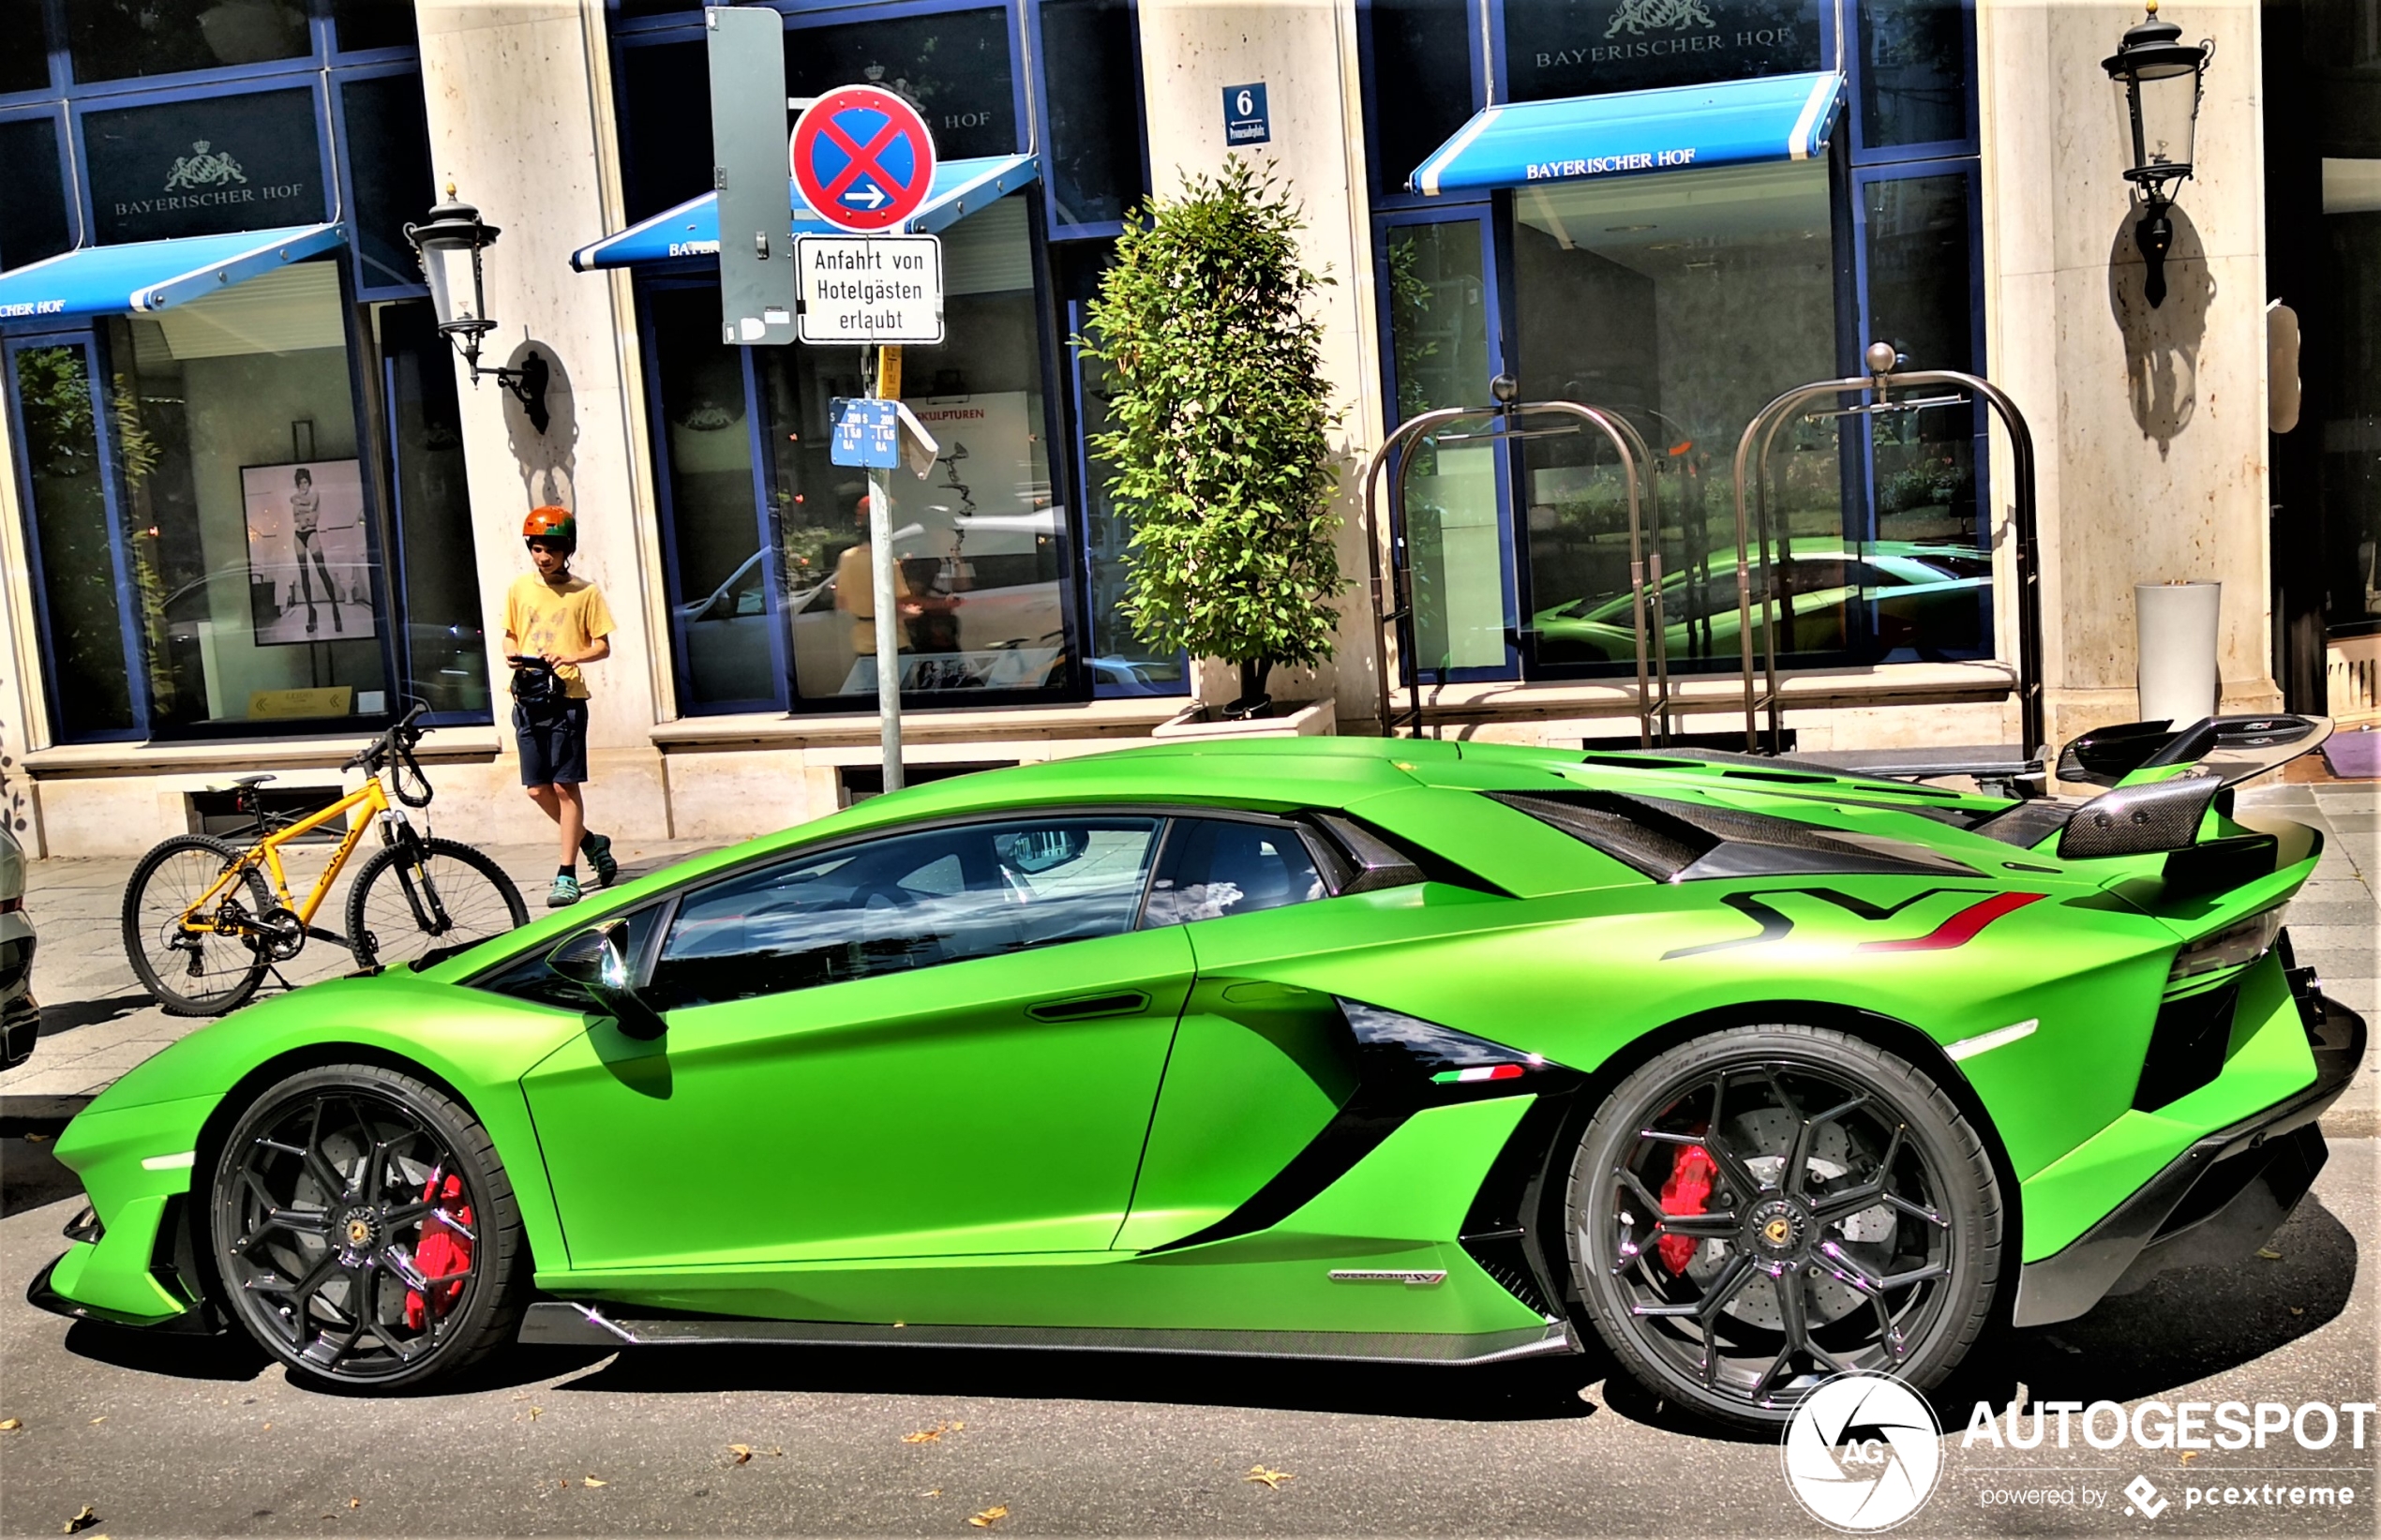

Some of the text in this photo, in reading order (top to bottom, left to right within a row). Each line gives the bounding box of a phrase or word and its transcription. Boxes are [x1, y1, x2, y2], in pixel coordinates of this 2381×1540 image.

[1535, 35, 1723, 67] BAYERISCHER
[1236, 89, 1253, 116] 6
[945, 112, 991, 129] HOF
[1526, 148, 1696, 180] BAYERISCHER HOF
[115, 183, 304, 216] BAYERISCHER HOF
[815, 249, 923, 270] Anfahrt von
[817, 279, 921, 306] Hotelgästen
[37, 299, 67, 314] HOF
[840, 309, 903, 329] erlaubt
